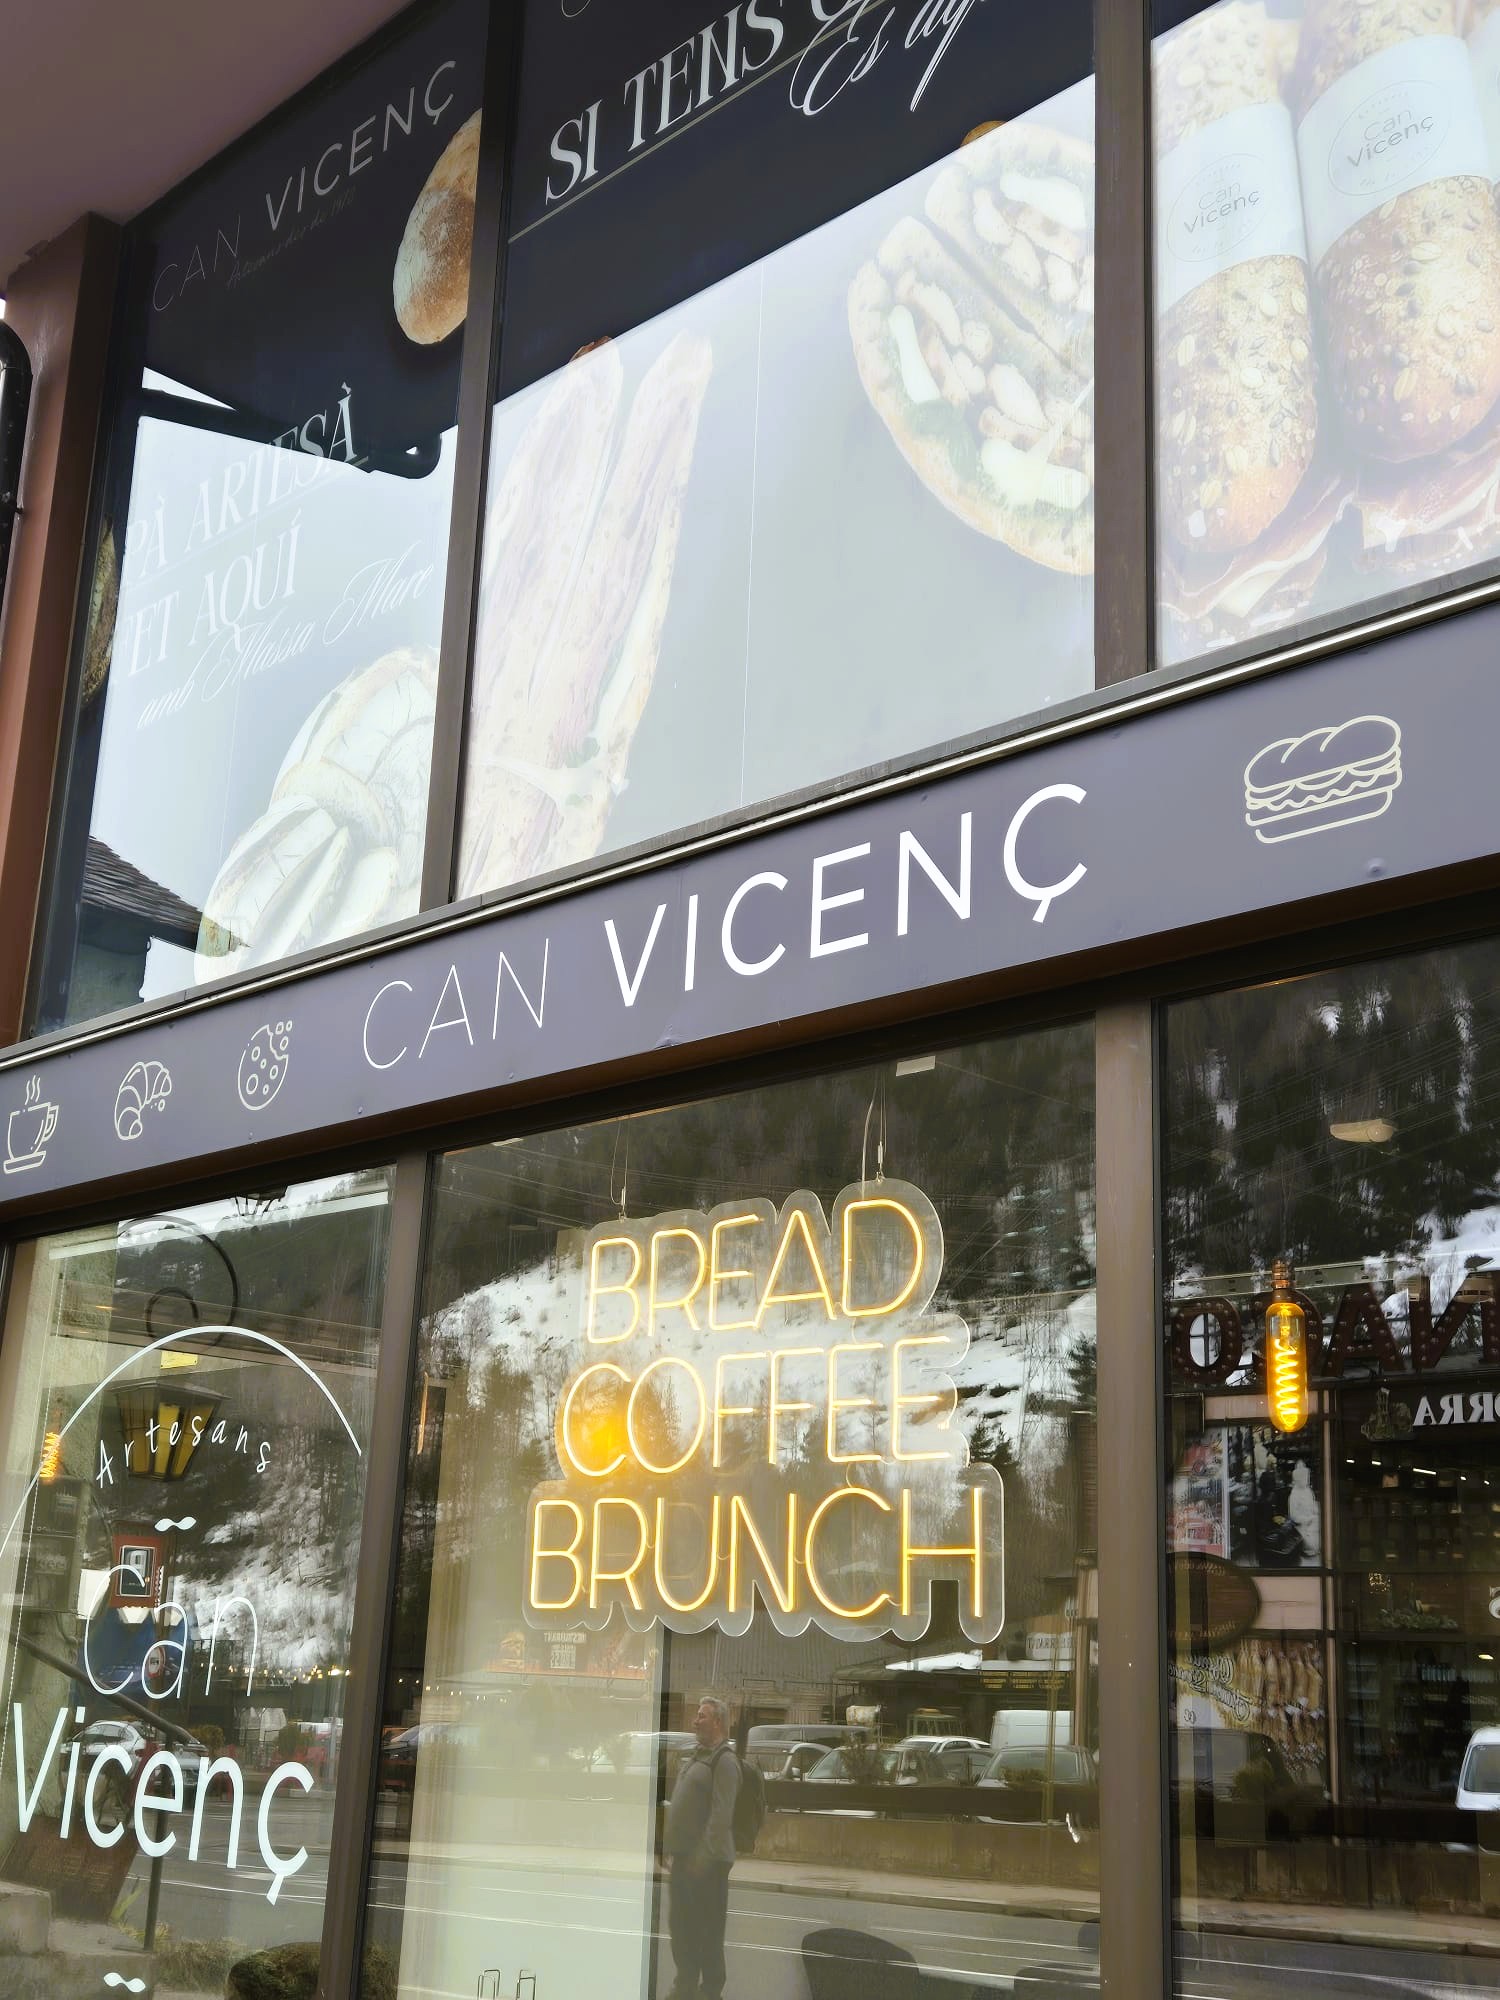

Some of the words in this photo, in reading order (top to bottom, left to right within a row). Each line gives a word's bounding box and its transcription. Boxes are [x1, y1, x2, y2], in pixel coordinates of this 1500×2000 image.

[545, 99, 602, 205] SI
[623, 0, 784, 153] TENS
[152, 214, 241, 312] CAN
[265, 60, 456, 232] VICENÇ
[184, 381, 359, 553] ARTESÀ
[187, 508, 303, 652] AQUÍ
[361, 936, 550, 1070] CAN
[603, 782, 1089, 1009] VICENÇ
[587, 1197, 926, 1345] BREAD
[95, 1413, 272, 1490] Artesans
[562, 1335, 952, 1477] COFFEE
[529, 1486, 984, 1618] BRUNCH
[83, 1563, 259, 1700] Can
[12, 1702, 316, 1907] Vicenç
